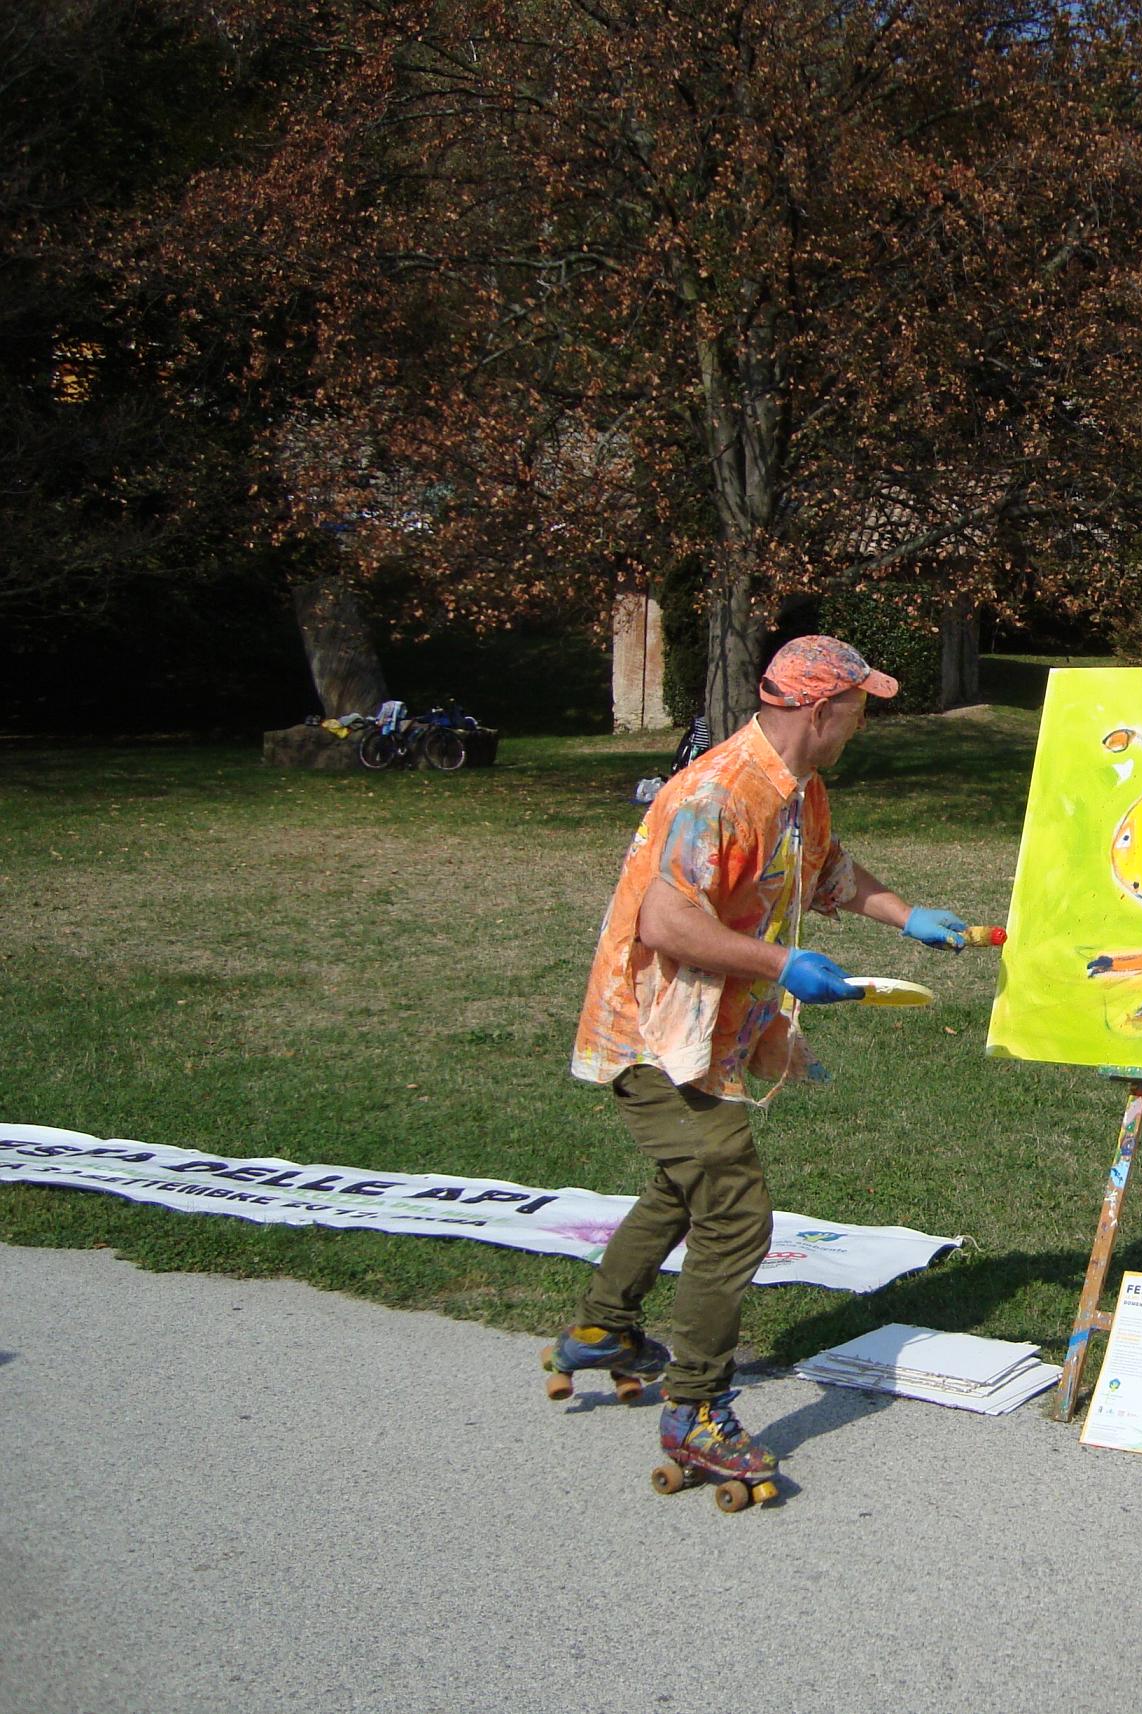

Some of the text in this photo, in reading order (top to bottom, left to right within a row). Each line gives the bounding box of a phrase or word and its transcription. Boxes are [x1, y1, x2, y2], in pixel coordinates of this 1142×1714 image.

[77, 1173, 281, 1205] SETTEMBRE
[160, 1161, 406, 1196] DELLE
[402, 1187, 560, 1214] API
